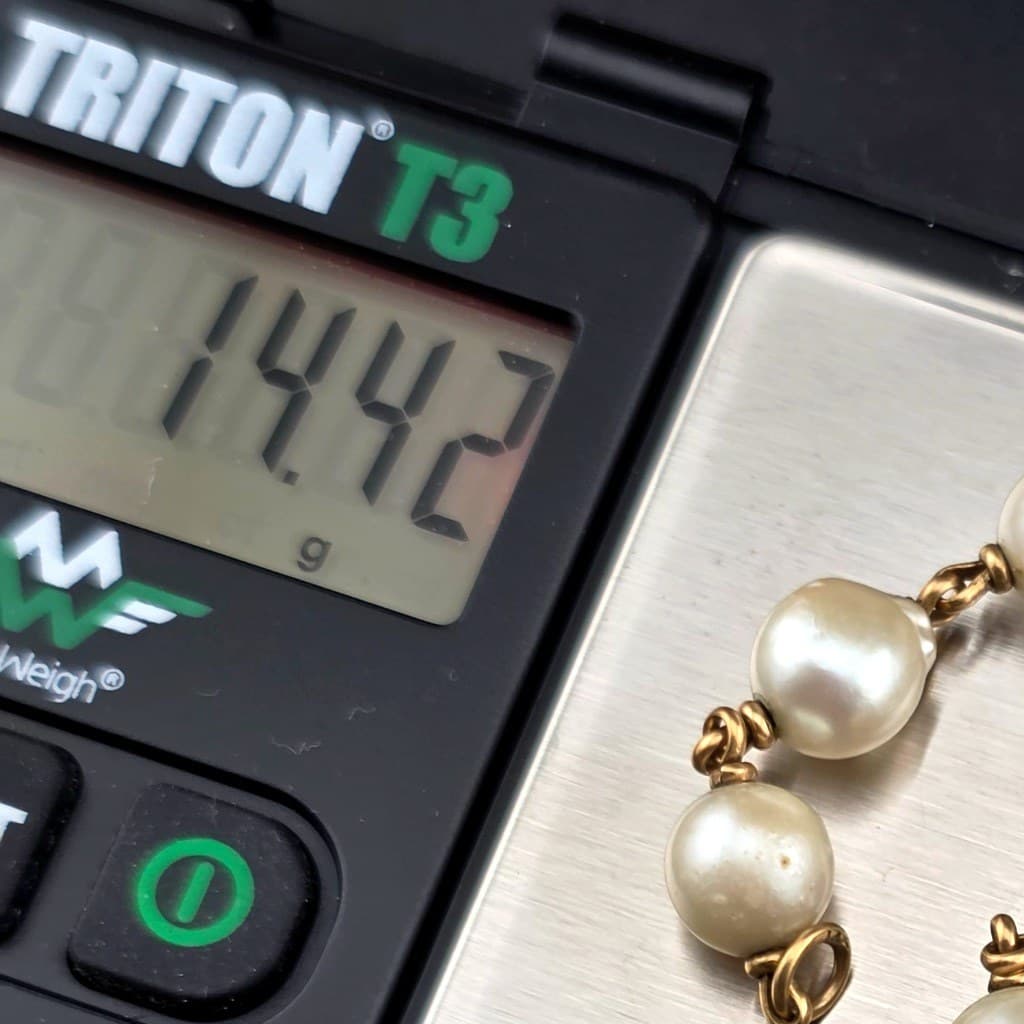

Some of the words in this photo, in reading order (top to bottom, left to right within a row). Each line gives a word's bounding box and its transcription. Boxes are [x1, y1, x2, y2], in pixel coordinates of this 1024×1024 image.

[379, 143, 514, 263] T3
[163, 275, 556, 542] 14.42
[297, 535, 332, 571] g
